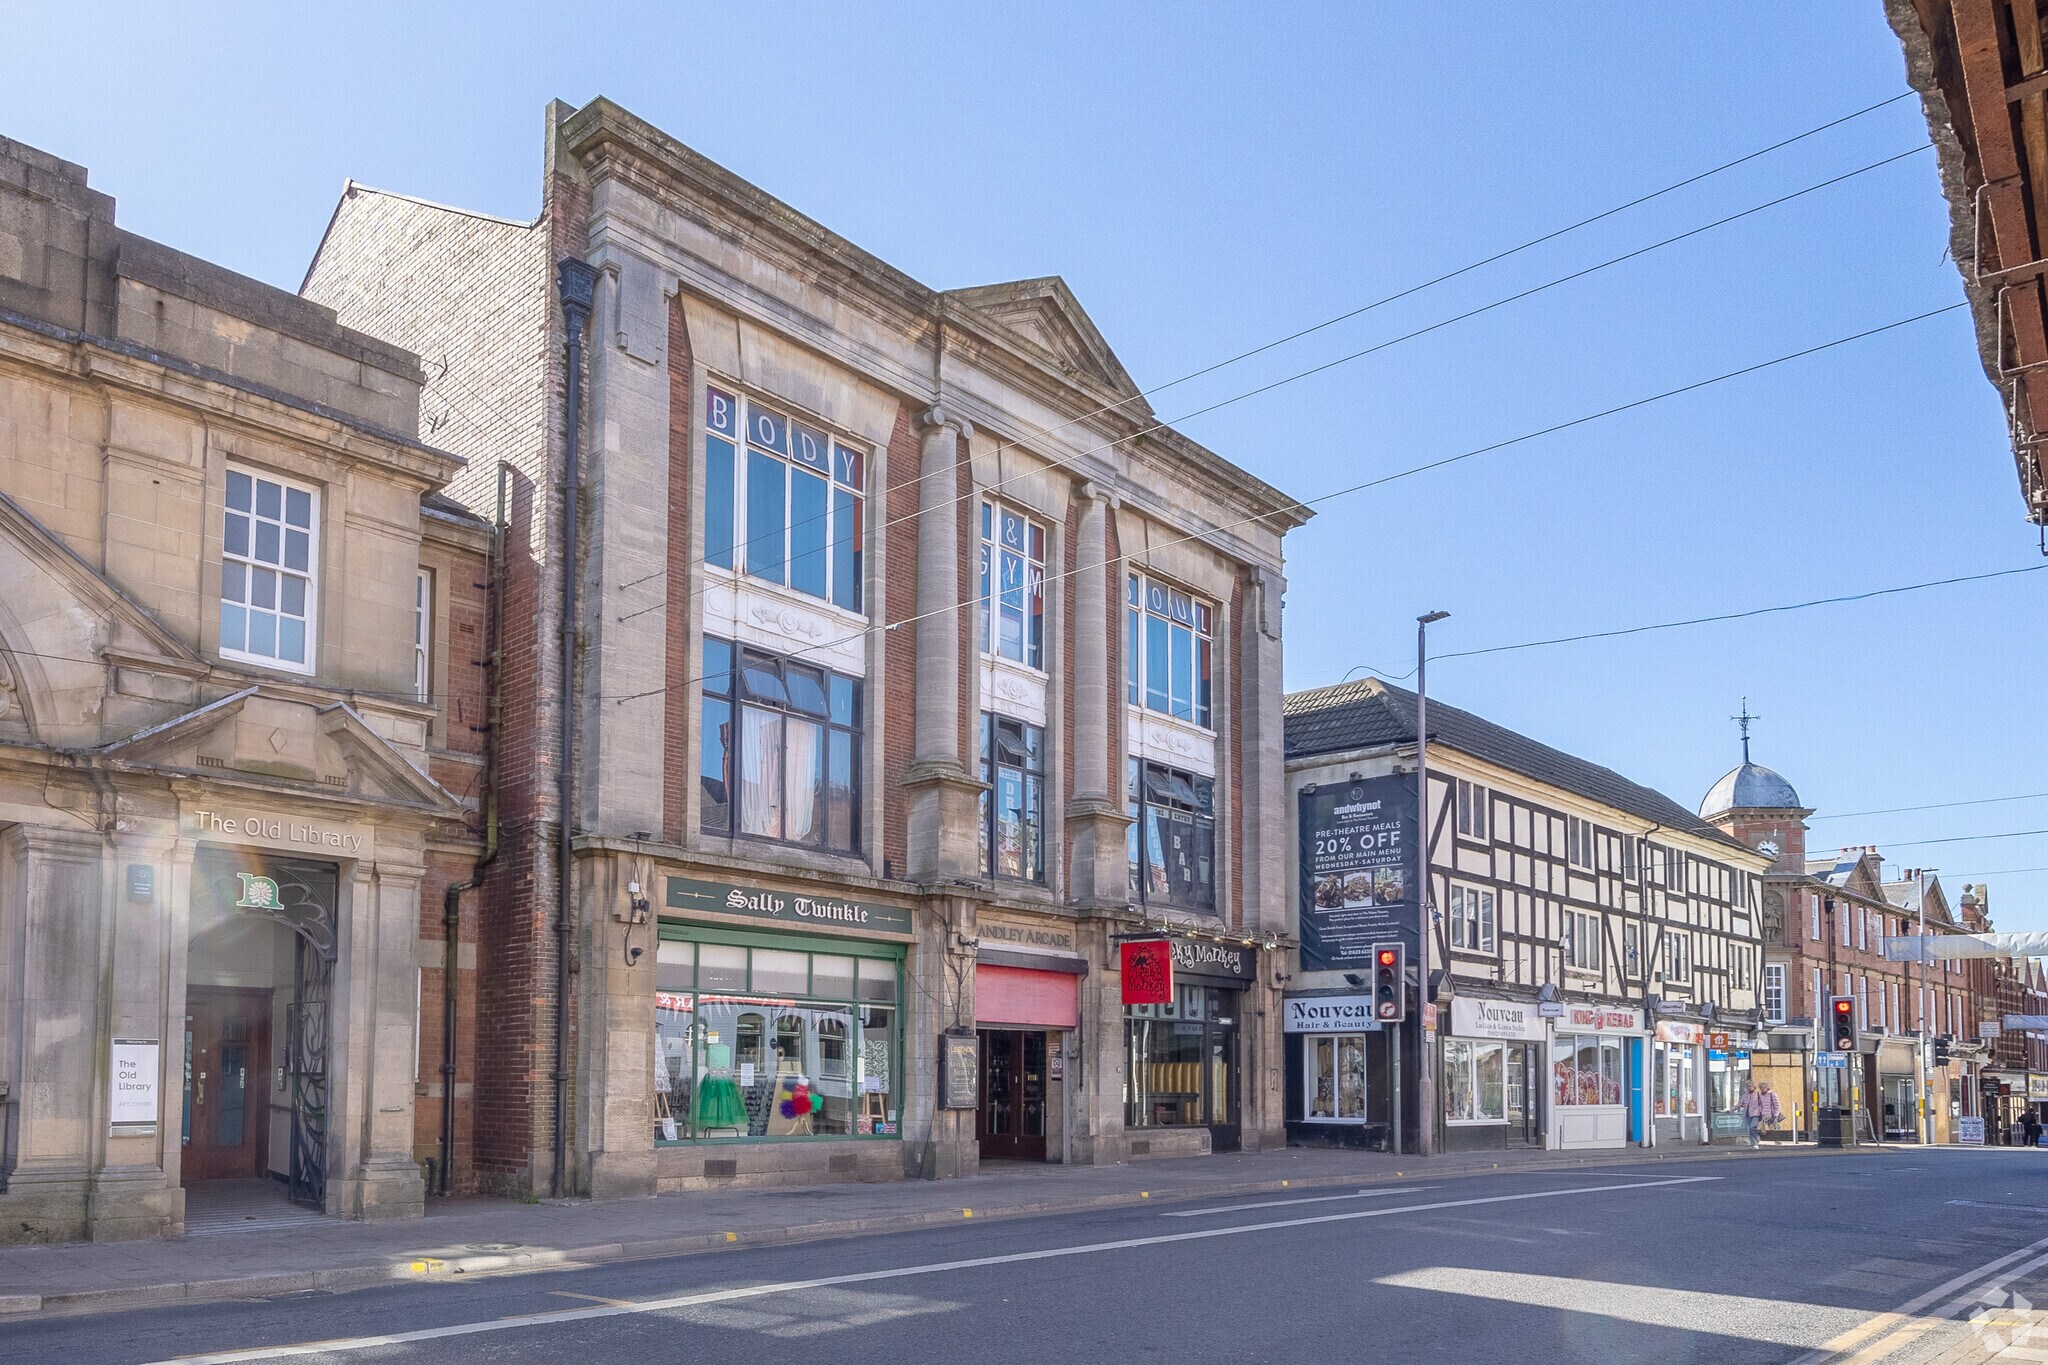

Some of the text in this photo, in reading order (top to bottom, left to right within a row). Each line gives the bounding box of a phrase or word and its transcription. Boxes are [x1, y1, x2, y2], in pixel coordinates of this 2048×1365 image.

[713, 394, 855, 483] BODY
[1006, 518, 1018, 546] &
[1333, 799, 1382, 816] andwhynot
[195, 811, 362, 853] The Old Library
[1315, 821, 1401, 839] PRE-THEATRE MEALS
[1315, 831, 1401, 855] 20% OFF
[1315, 848, 1402, 863] FROM OUR MAIN MENU
[1315, 855, 1402, 870] WEDNESDAY-SATURDAY
[725, 889, 869, 923] Sally Twinkle
[1026, 929, 1071, 947] ARCADE
[1195, 944, 1241, 974] Monkey
[1476, 1001, 1524, 1023] Nouveau
[1297, 1020, 1373, 1029] Hair & Beauty
[119, 1060, 136, 1068] The
[119, 1071, 137, 1079] Old
[119, 1083, 152, 1092] Library
